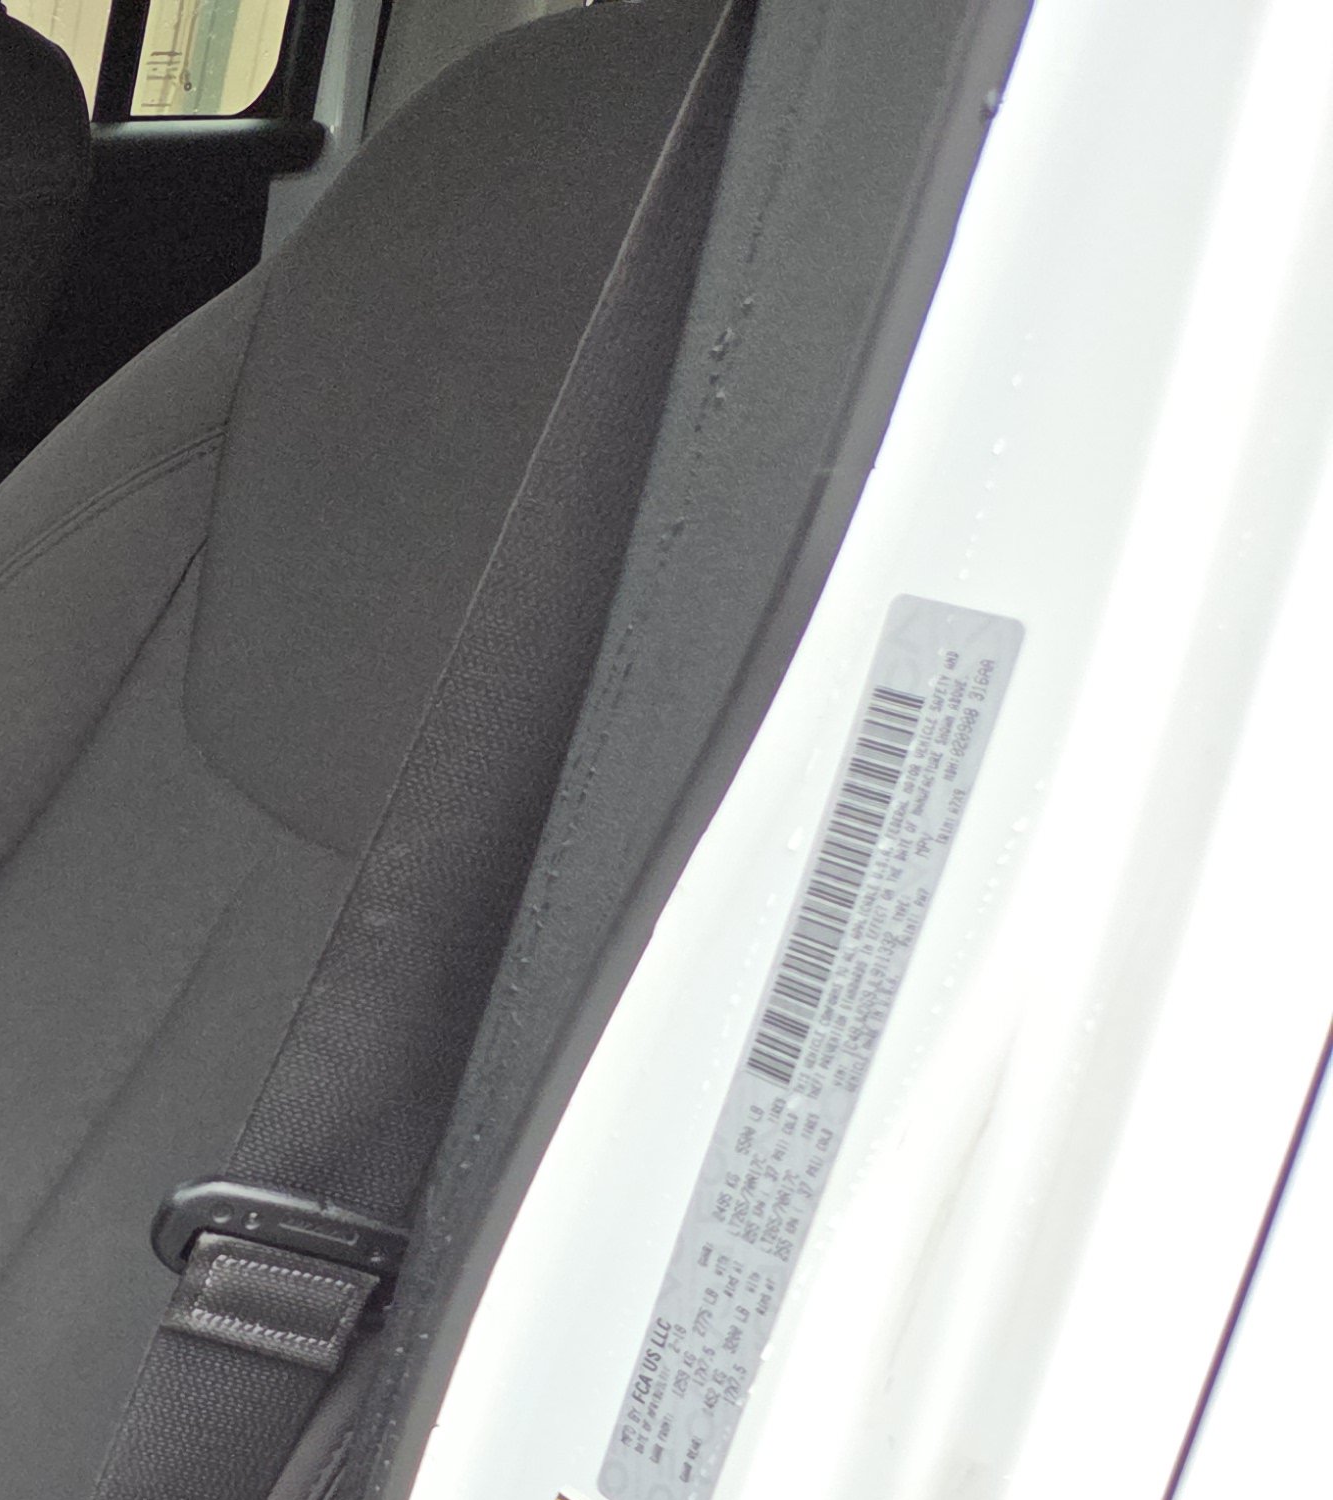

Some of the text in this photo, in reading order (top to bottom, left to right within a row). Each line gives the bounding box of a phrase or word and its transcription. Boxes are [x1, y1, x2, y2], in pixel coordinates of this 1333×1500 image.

[927, 673, 953, 713] SAFETY
[912, 830, 936, 858] MPV
[722, 1169, 741, 1190] KG
[744, 1103, 764, 1123] LB
[649, 1315, 672, 1349] LLC
[666, 1322, 687, 1354] 2-18
[680, 1349, 697, 1369] KG
[702, 1286, 719, 1306] LB
[641, 1347, 661, 1373] US
[710, 1366, 728, 1387] KG
[731, 1303, 750, 1324] LB
[630, 1371, 653, 1405] FCA
